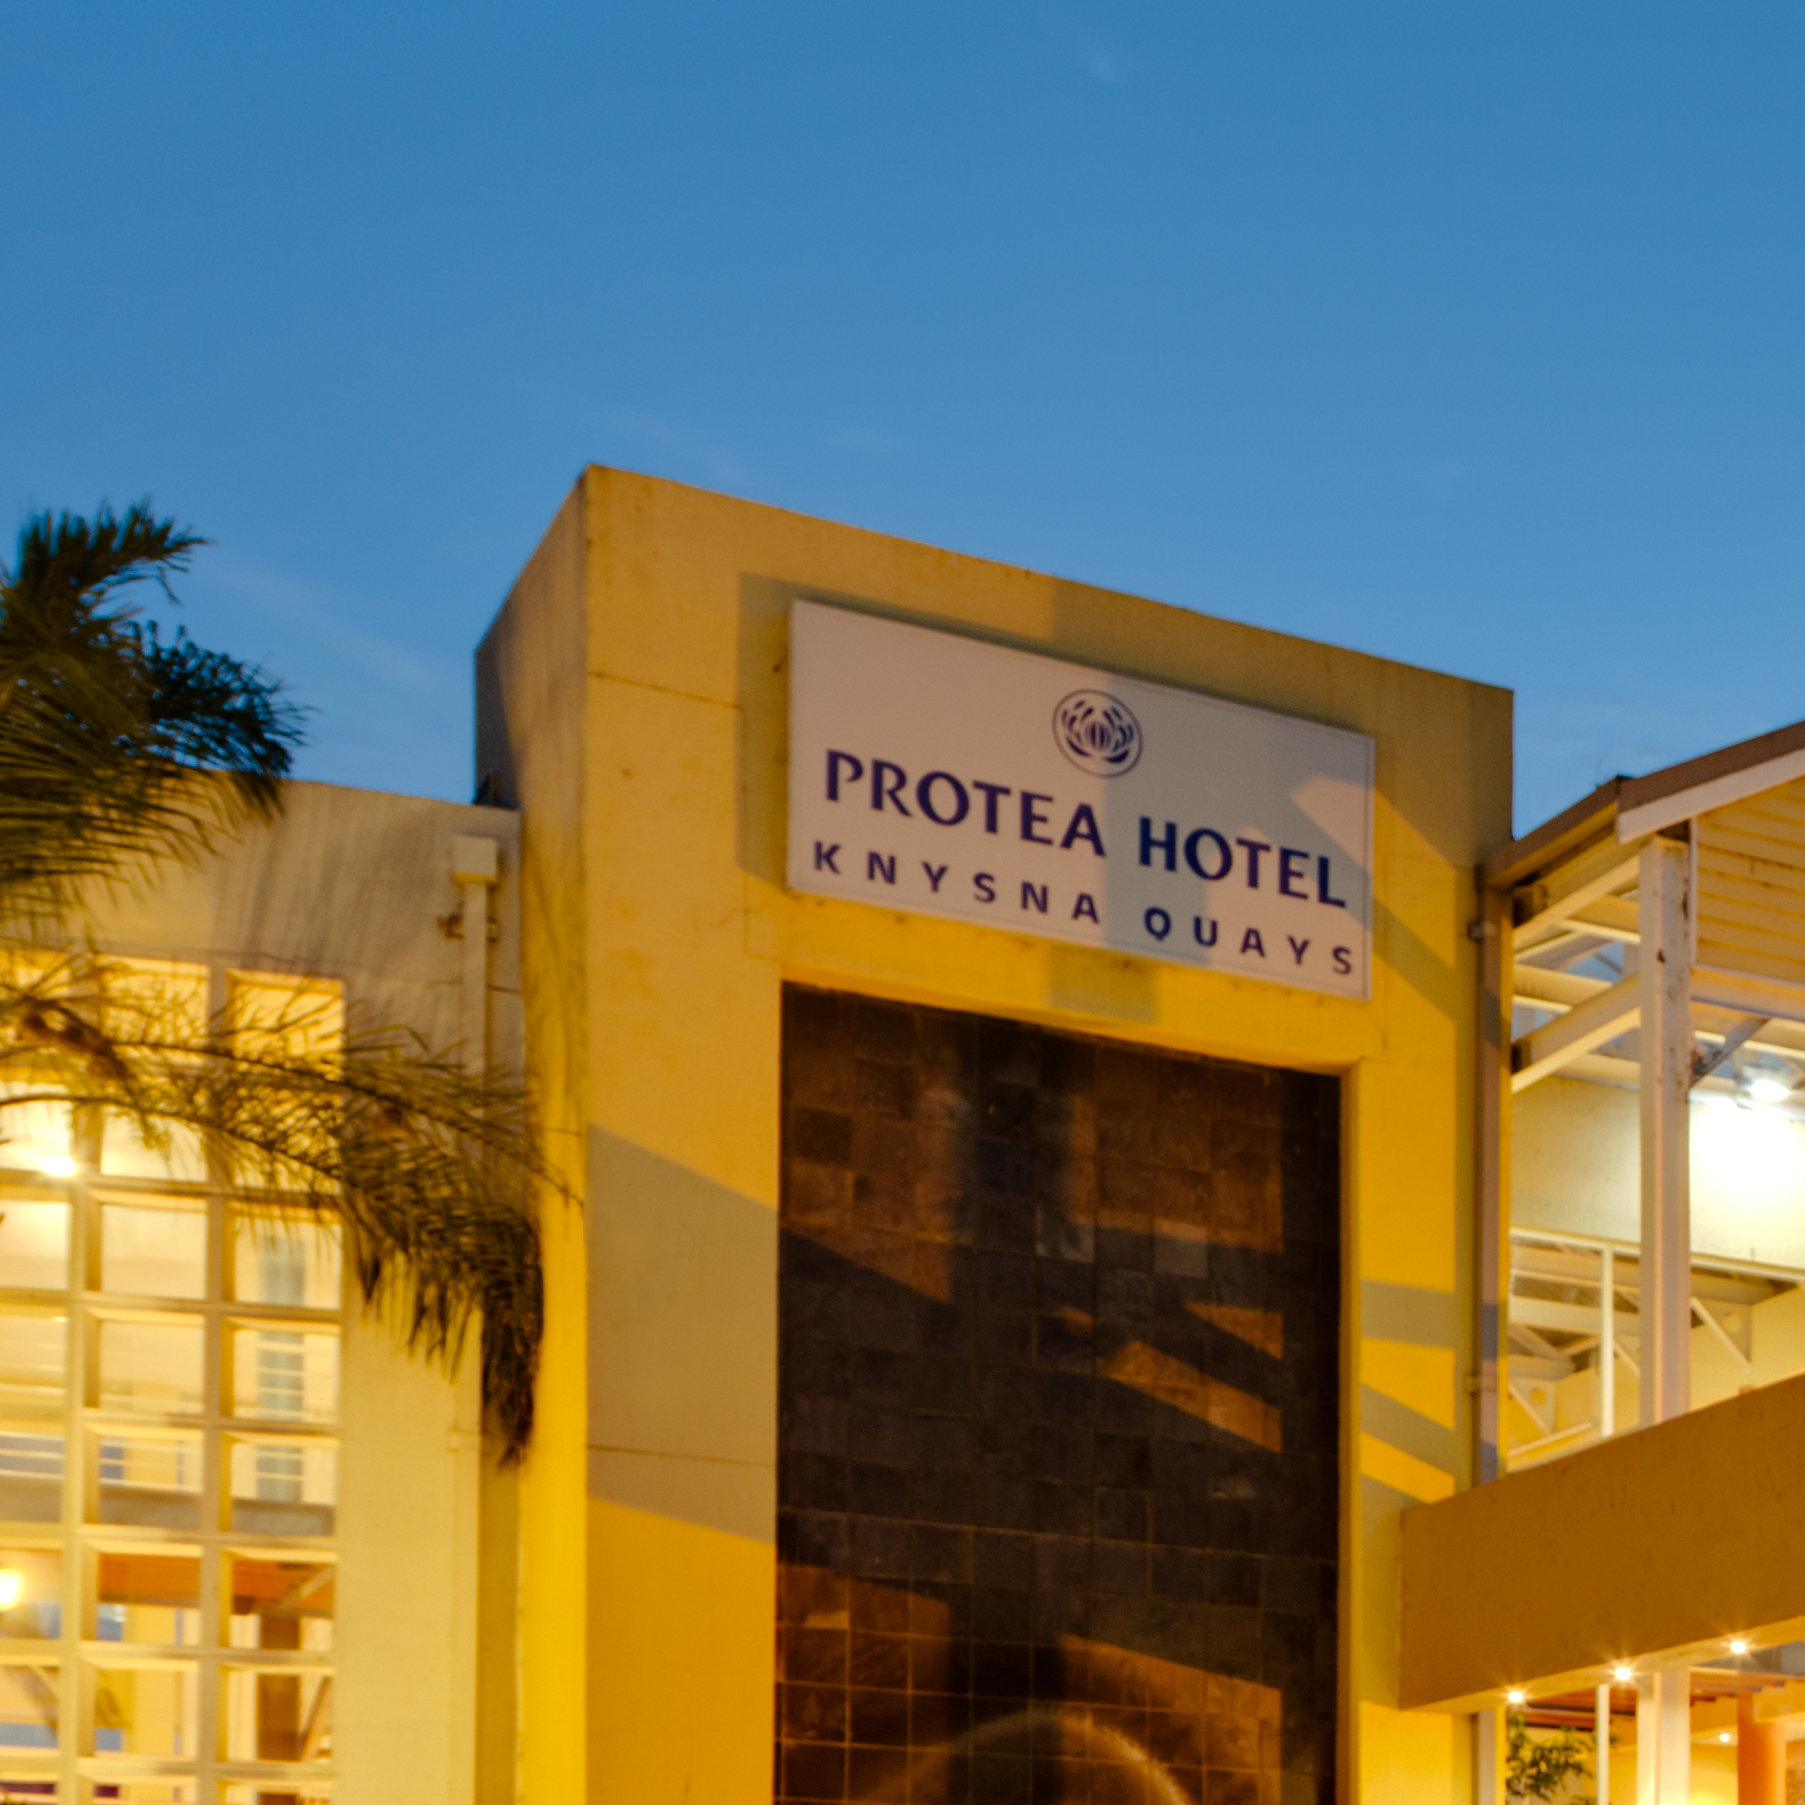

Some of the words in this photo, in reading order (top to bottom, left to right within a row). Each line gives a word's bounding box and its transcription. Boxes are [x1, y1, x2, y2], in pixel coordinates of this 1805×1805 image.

[826, 750, 1106, 858] PROTEA
[1138, 815, 1347, 909] HOTEL
[814, 840, 1100, 925] KNYSNA
[1143, 906, 1354, 976] QUAYS
